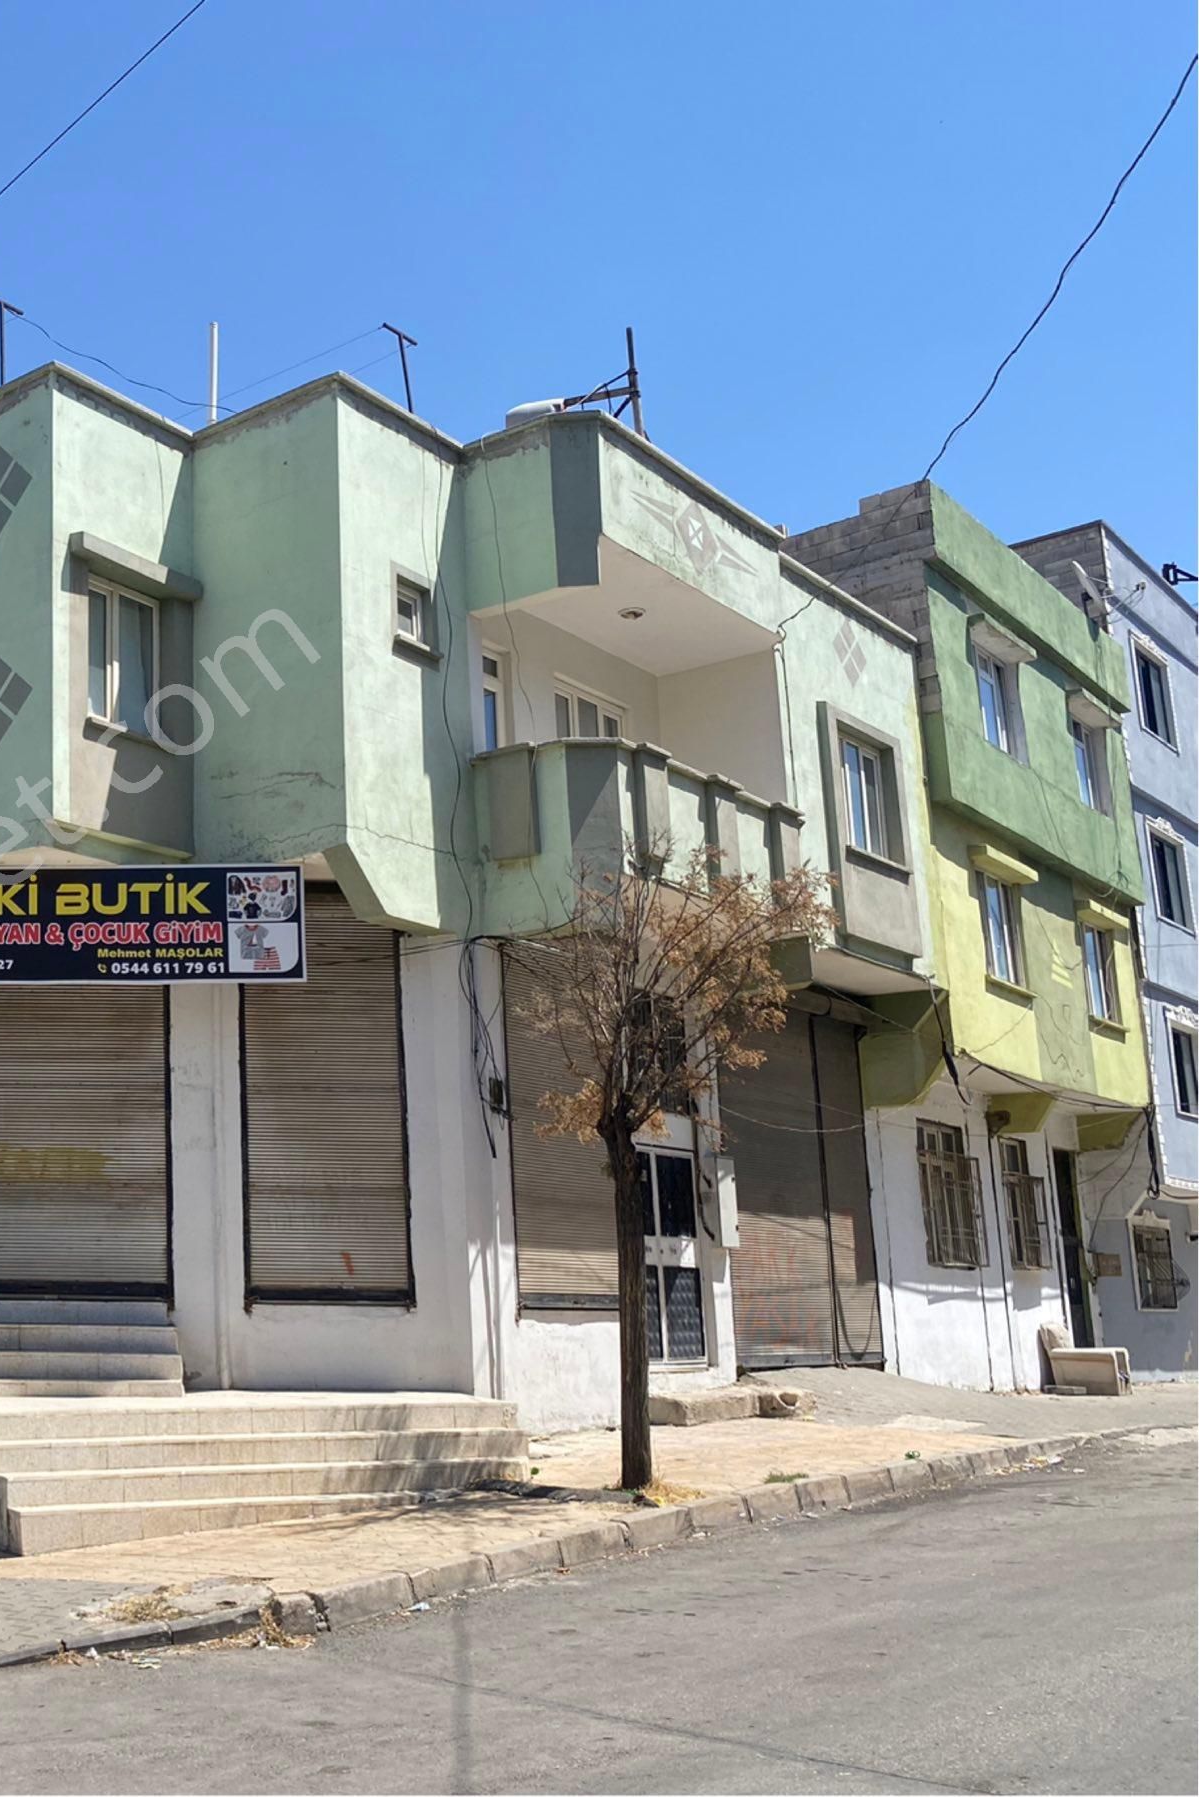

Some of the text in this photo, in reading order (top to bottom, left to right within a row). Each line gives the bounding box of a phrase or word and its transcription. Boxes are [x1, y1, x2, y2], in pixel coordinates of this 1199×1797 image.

[56, 873, 211, 915] BUTİK
[45, 922, 65, 944] &
[69, 920, 149, 950] ÇOCUK
[97, 948, 223, 960] Mehmet MAŞOLAR
[111, 962, 224, 974] 0544 611 79 61
